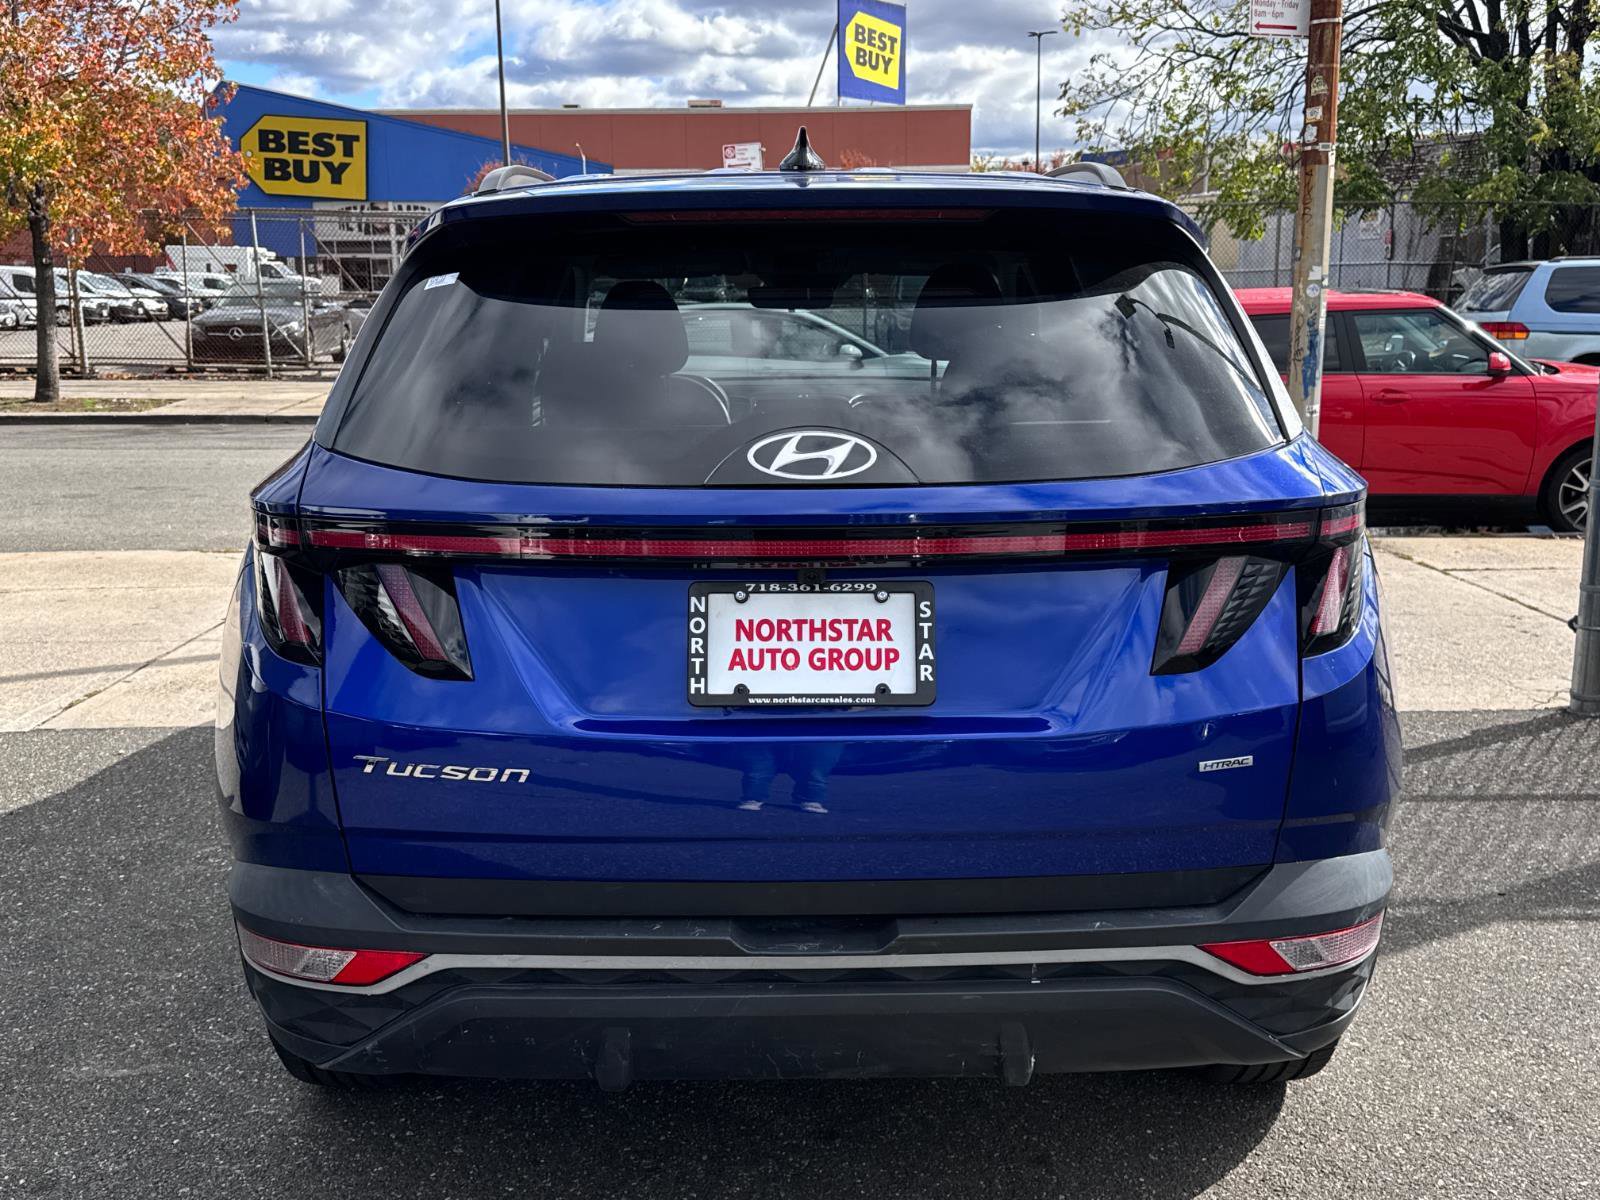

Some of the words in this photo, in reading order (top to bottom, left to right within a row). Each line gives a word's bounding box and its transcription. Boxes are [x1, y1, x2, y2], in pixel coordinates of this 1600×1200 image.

[854, 22, 897, 55] BEST
[855, 46, 893, 75] BUY
[258, 129, 360, 158] BEST
[264, 157, 352, 185] BUY
[745, 583, 877, 592] 718-361-6299
[735, 618, 893, 642] NORTHSTAR
[919, 601, 934, 682] STAR
[689, 596, 706, 694] NORTH
[728, 648, 800, 671] AUTO
[808, 648, 900, 671] GROUP
[748, 696, 875, 704] www.northstarcarsales.com
[1203, 758, 1250, 770] HTRAC
